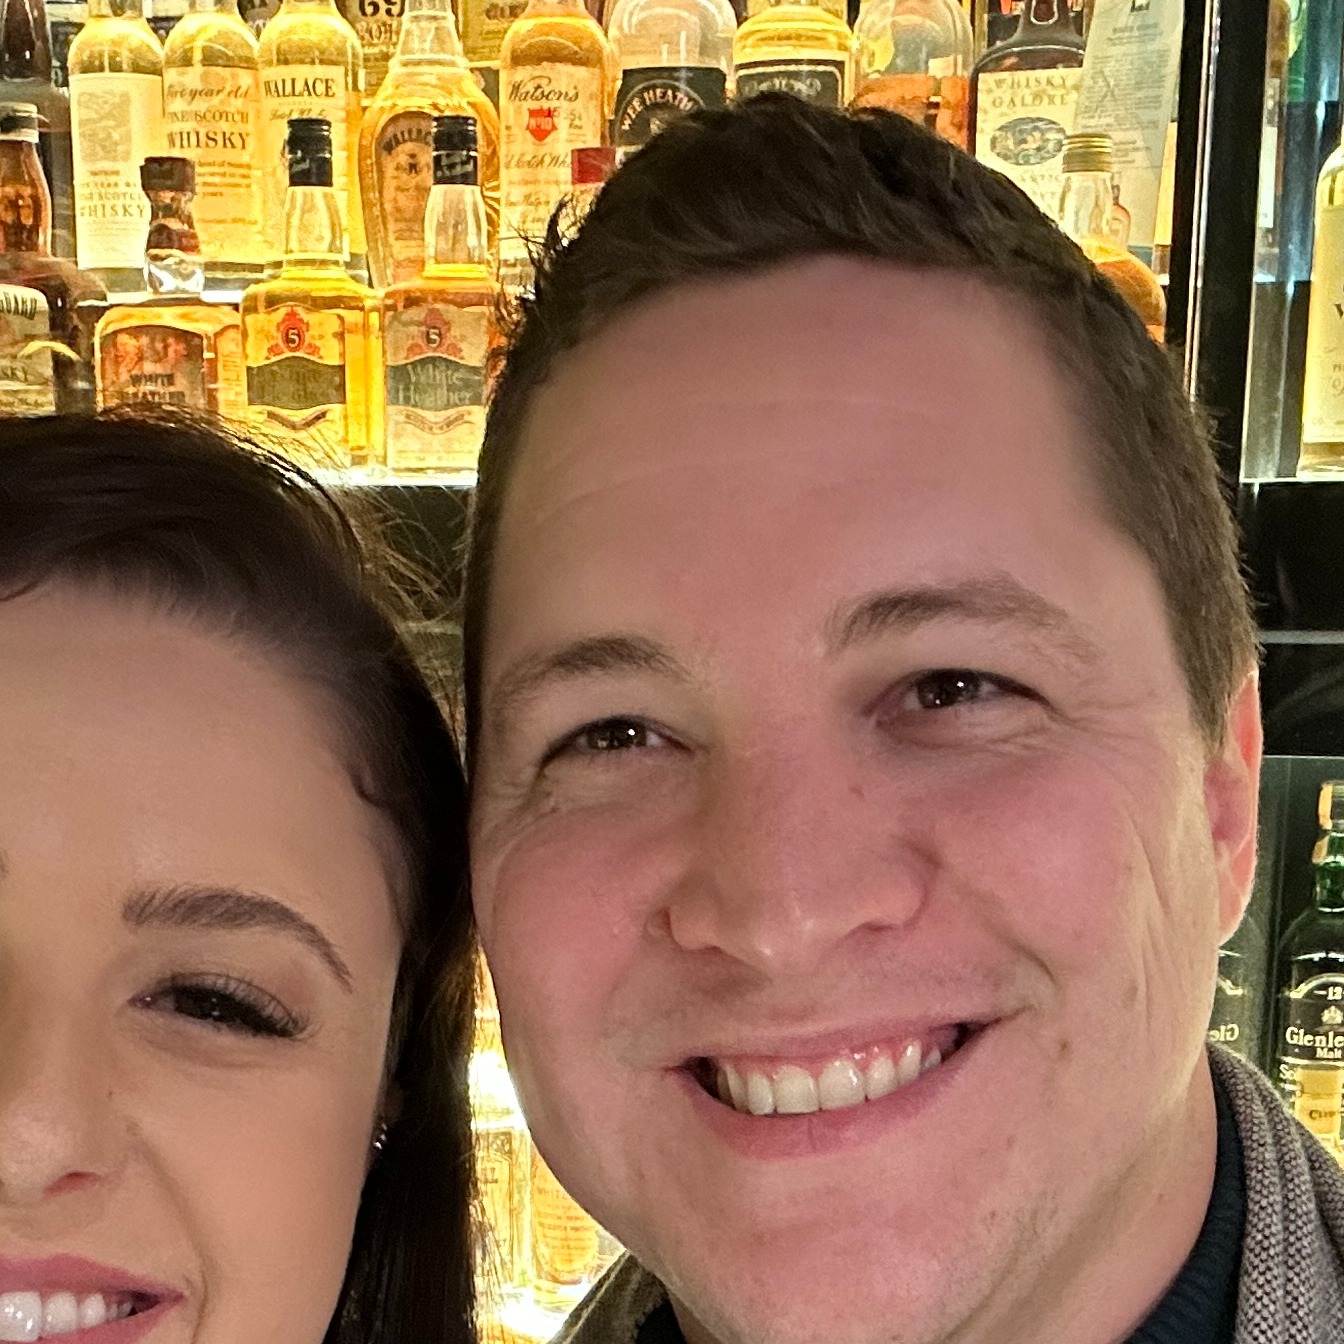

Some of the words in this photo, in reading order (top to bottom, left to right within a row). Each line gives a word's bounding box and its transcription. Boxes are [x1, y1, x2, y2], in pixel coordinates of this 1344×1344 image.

[264, 77, 336, 98] WALLACE
[508, 75, 580, 103] Watson's
[994, 76, 1068, 90] WHISKY
[992, 94, 1069, 109] GALORE
[194, 110, 249, 124] SCOTCH
[621, 99, 644, 131] WEE
[167, 130, 251, 150] WHISKY
[285, 328, 301, 348] 5
[425, 328, 441, 348] 5
[406, 360, 461, 385] White
[397, 384, 473, 406] Heather
[1326, 986, 1343, 1000] 12
[1315, 1047, 1342, 1059] Malt
